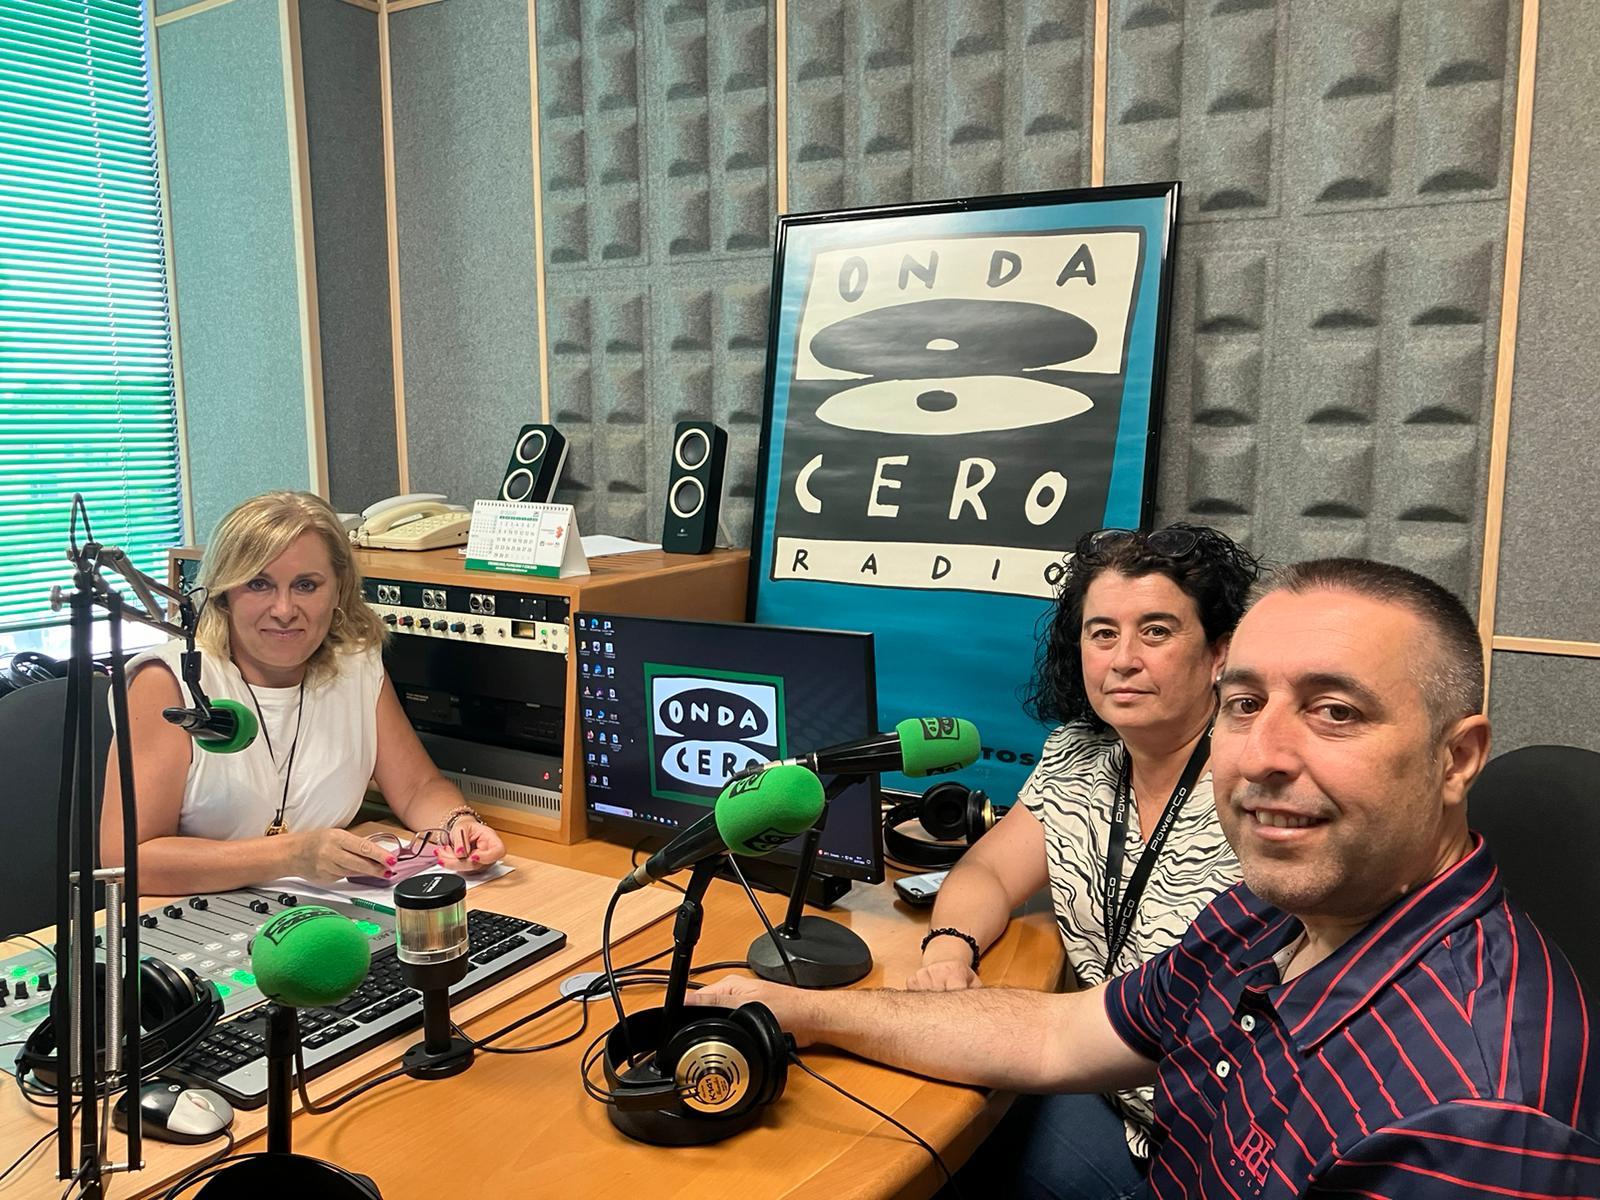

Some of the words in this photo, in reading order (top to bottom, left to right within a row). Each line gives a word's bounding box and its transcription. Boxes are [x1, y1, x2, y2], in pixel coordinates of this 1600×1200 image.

[838, 243, 1097, 303] ONDA
[794, 453, 1067, 526] CERO
[792, 549, 1066, 585] RADIO
[668, 700, 758, 731] ONDA
[1150, 787, 1187, 851] PowerCo
